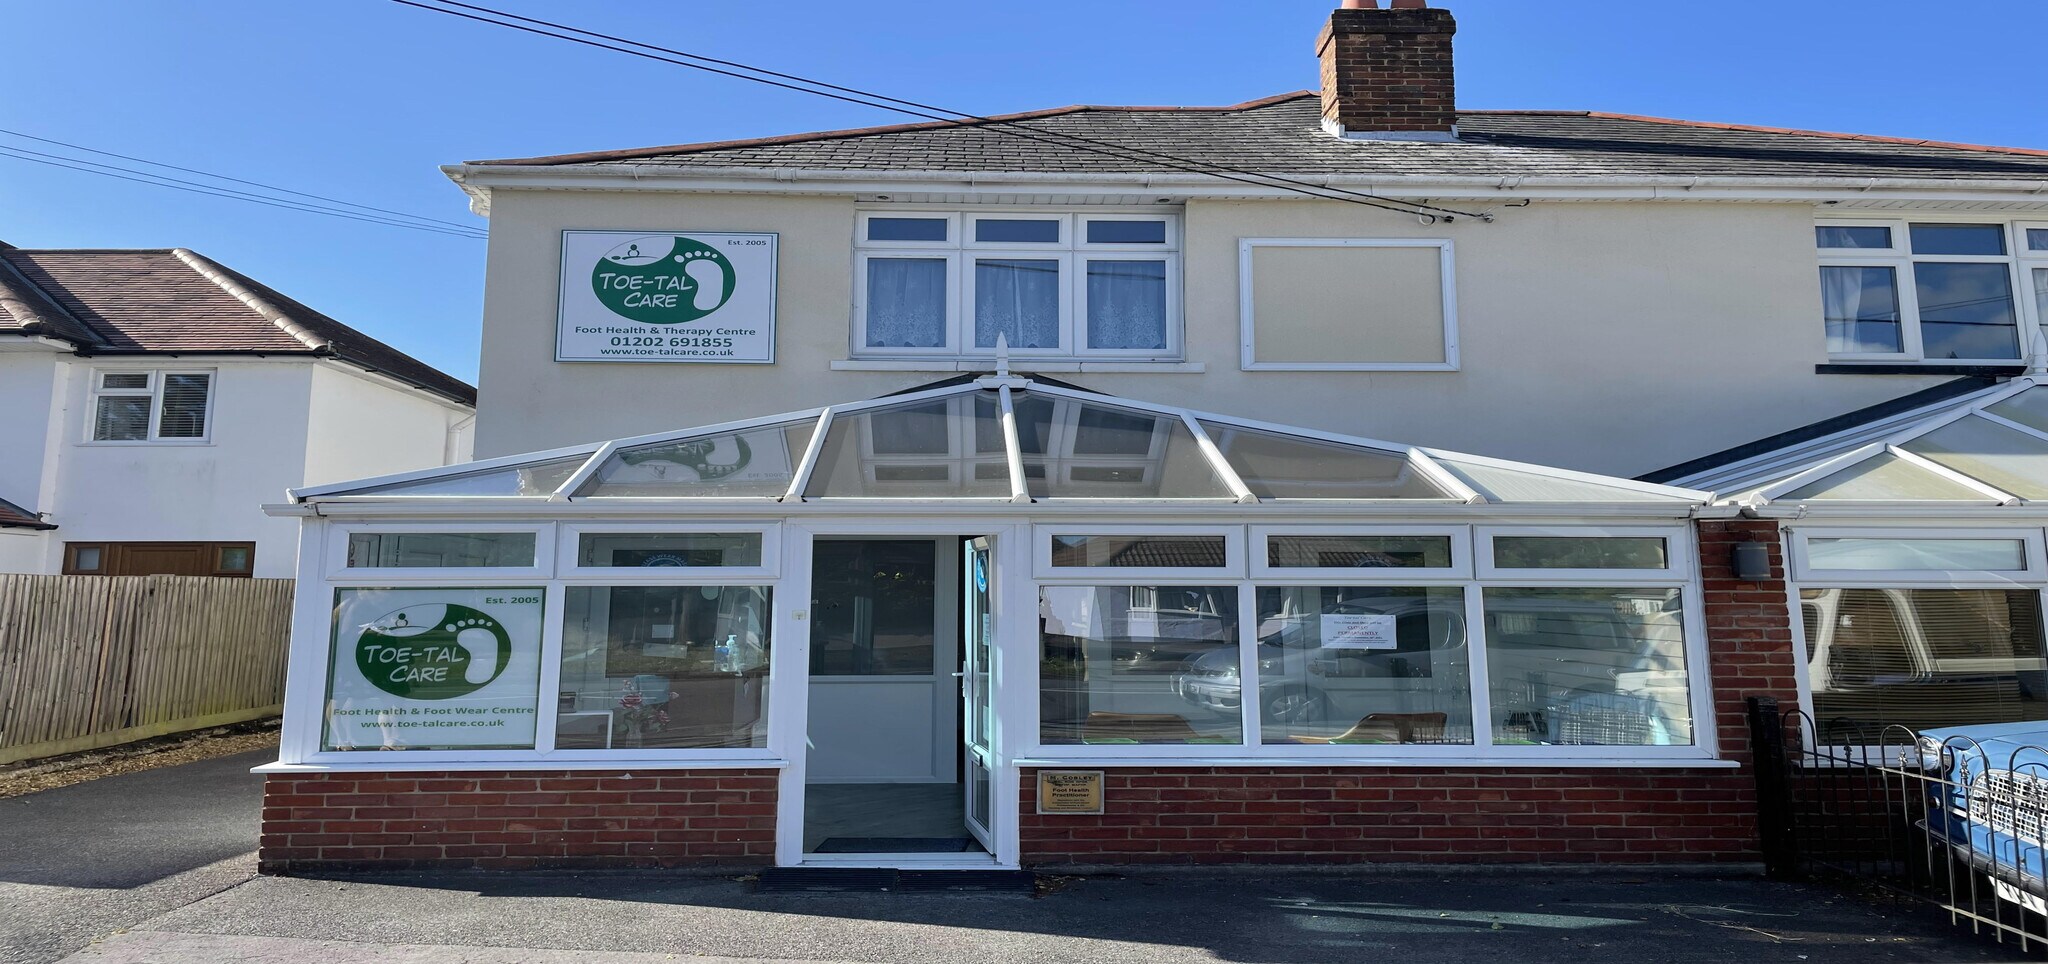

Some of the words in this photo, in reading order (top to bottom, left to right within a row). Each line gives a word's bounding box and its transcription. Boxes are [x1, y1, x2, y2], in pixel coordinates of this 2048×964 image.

[599, 272, 693, 290] TOE-TAL
[623, 292, 678, 308] CARE
[575, 326, 602, 334] Foot
[606, 326, 646, 335] Health
[649, 327, 660, 335] &
[664, 327, 713, 336] Therapy
[716, 328, 756, 336] Centre
[610, 336, 664, 347] 01202
[669, 337, 733, 348] 691855
[600, 348, 734, 357] www.toe-talcare.co.uk
[364, 645, 465, 663] TOE-TAL
[389, 665, 449, 682] CARE
[364, 707, 407, 715] Health
[410, 707, 420, 715] &
[423, 707, 451, 715] Foot
[455, 707, 489, 715] Wear
[492, 706, 534, 714] Centre
[360, 720, 505, 728] www.toe-talcare.co.uk
